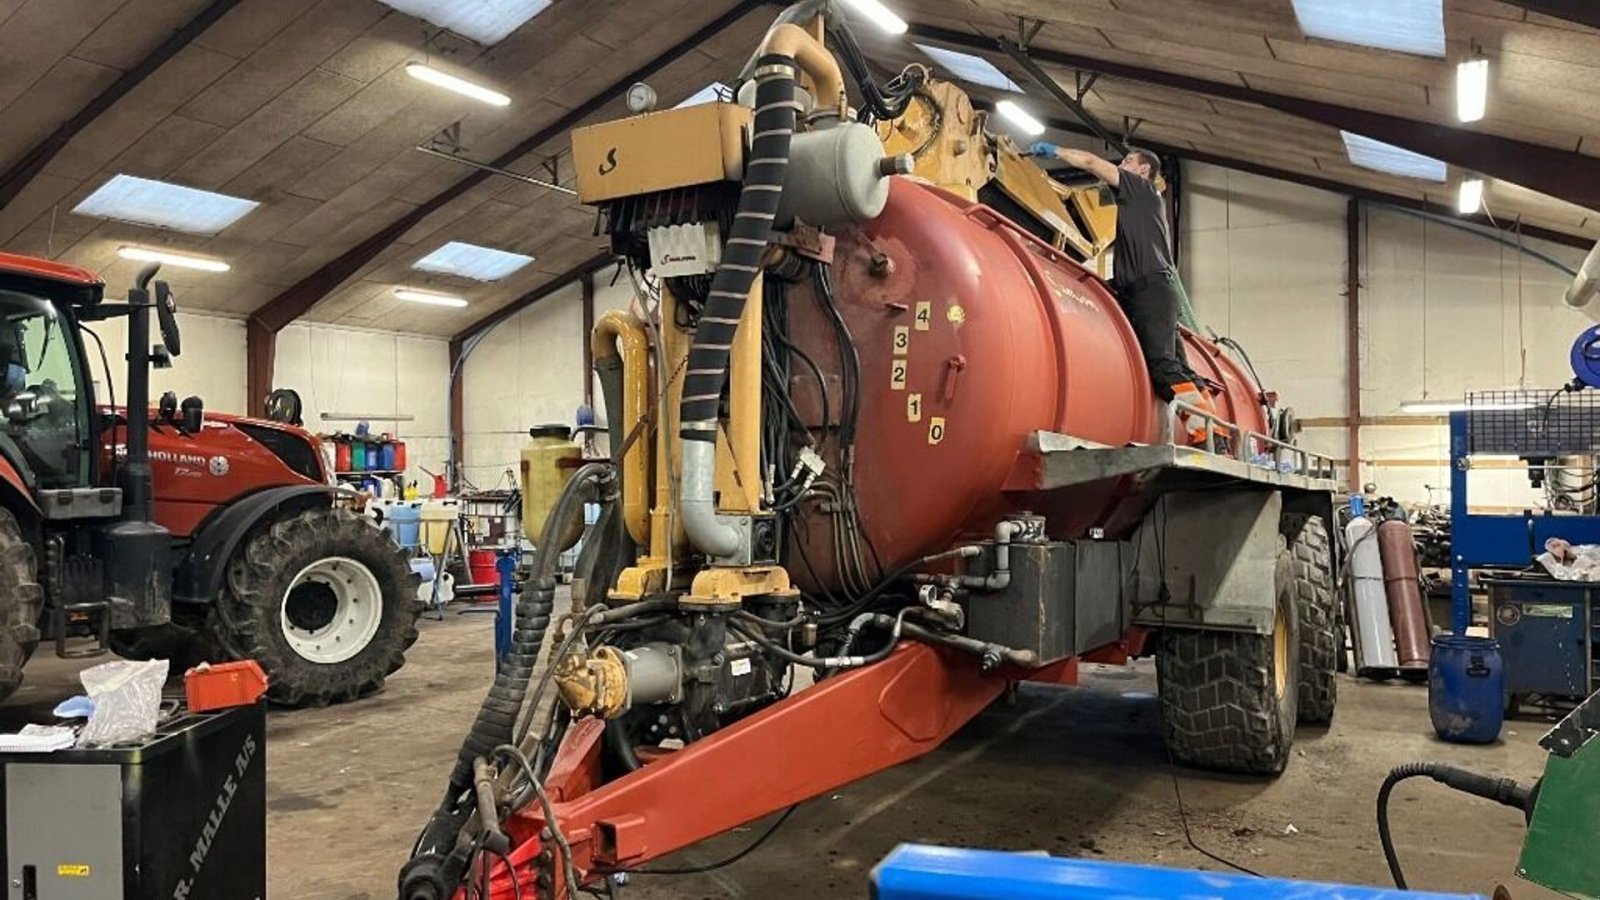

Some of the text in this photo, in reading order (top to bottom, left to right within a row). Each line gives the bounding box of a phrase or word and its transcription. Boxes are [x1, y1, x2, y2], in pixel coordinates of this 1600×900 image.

[917, 308, 928, 323] 4
[896, 333, 907, 347] 3
[894, 367, 905, 382] 2
[910, 400, 918, 415] 1
[931, 425, 942, 440] 0
[148, 450, 206, 465] HOLLAND
[189, 773, 238, 873] MALLE
[235, 733, 256, 778] A/S
